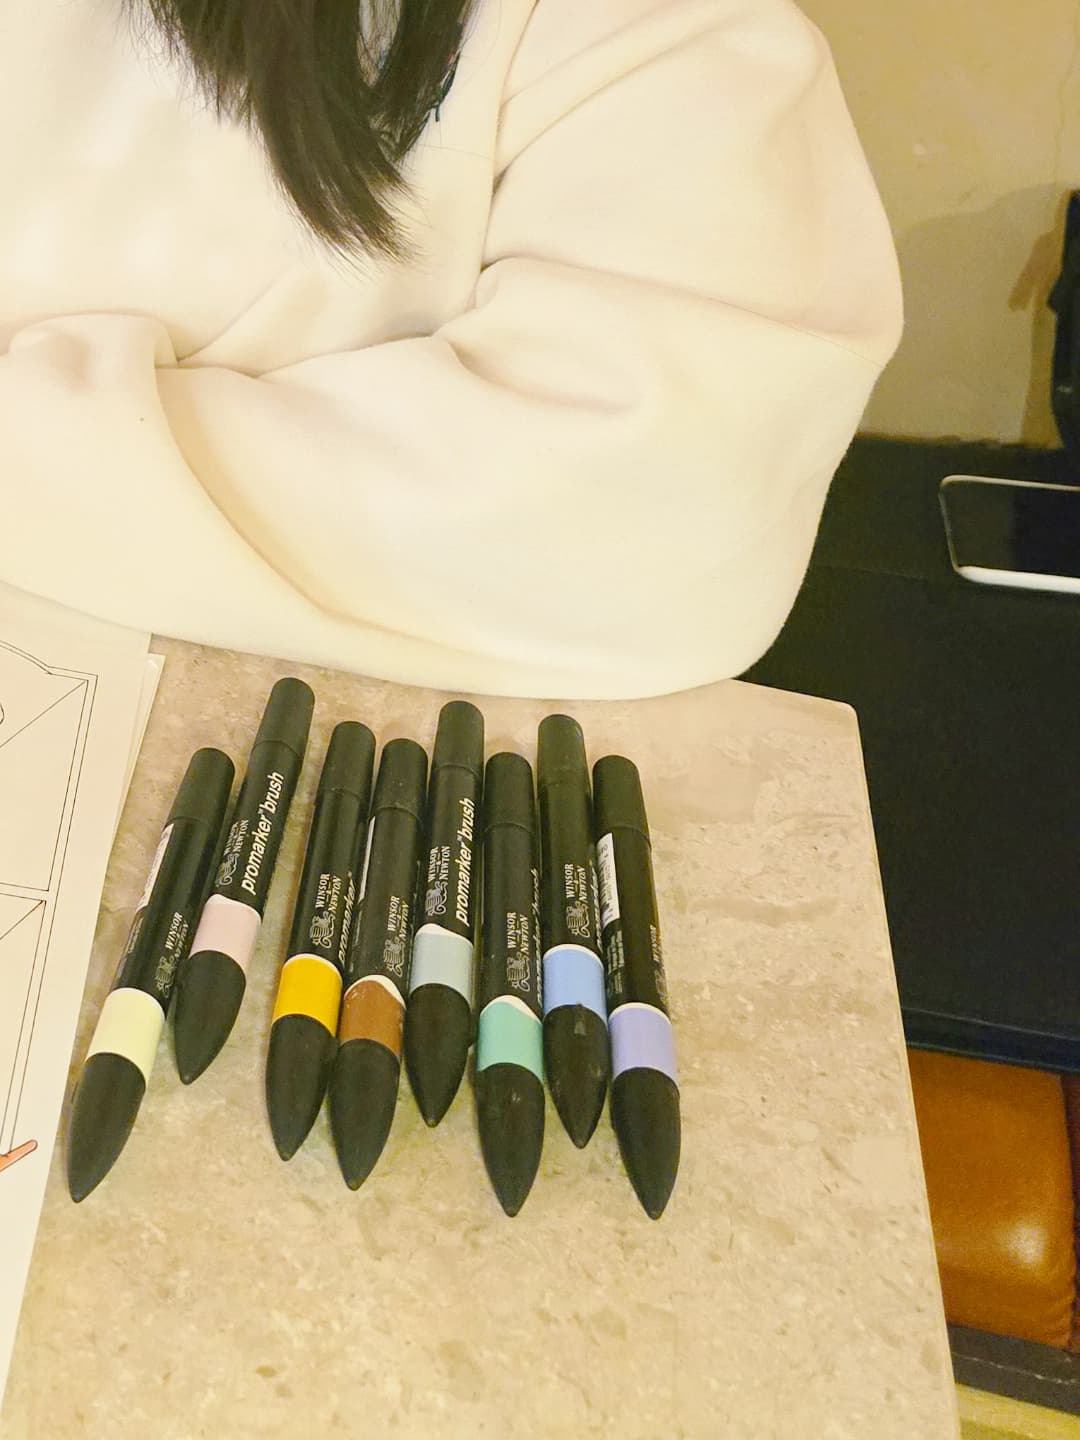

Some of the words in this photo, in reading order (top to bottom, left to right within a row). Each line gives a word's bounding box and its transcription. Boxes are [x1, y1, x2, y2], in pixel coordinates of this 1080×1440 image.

[232, 819, 249, 853] NEWTON
[241, 813, 273, 896] promarker
[259, 771, 285, 814] brush
[457, 797, 476, 842] brush
[428, 846, 439, 882] WINSOR
[439, 845, 451, 881] NEWTON
[564, 863, 574, 899] WINSOR
[315, 873, 331, 909] WINSOR
[328, 875, 342, 914] NEWTON
[455, 839, 473, 927] promarker
[165, 912, 183, 950] WINSOR
[387, 895, 400, 932] WINSOR
[507, 912, 516, 949] WINSOR
[520, 914, 530, 956] NEWTON
